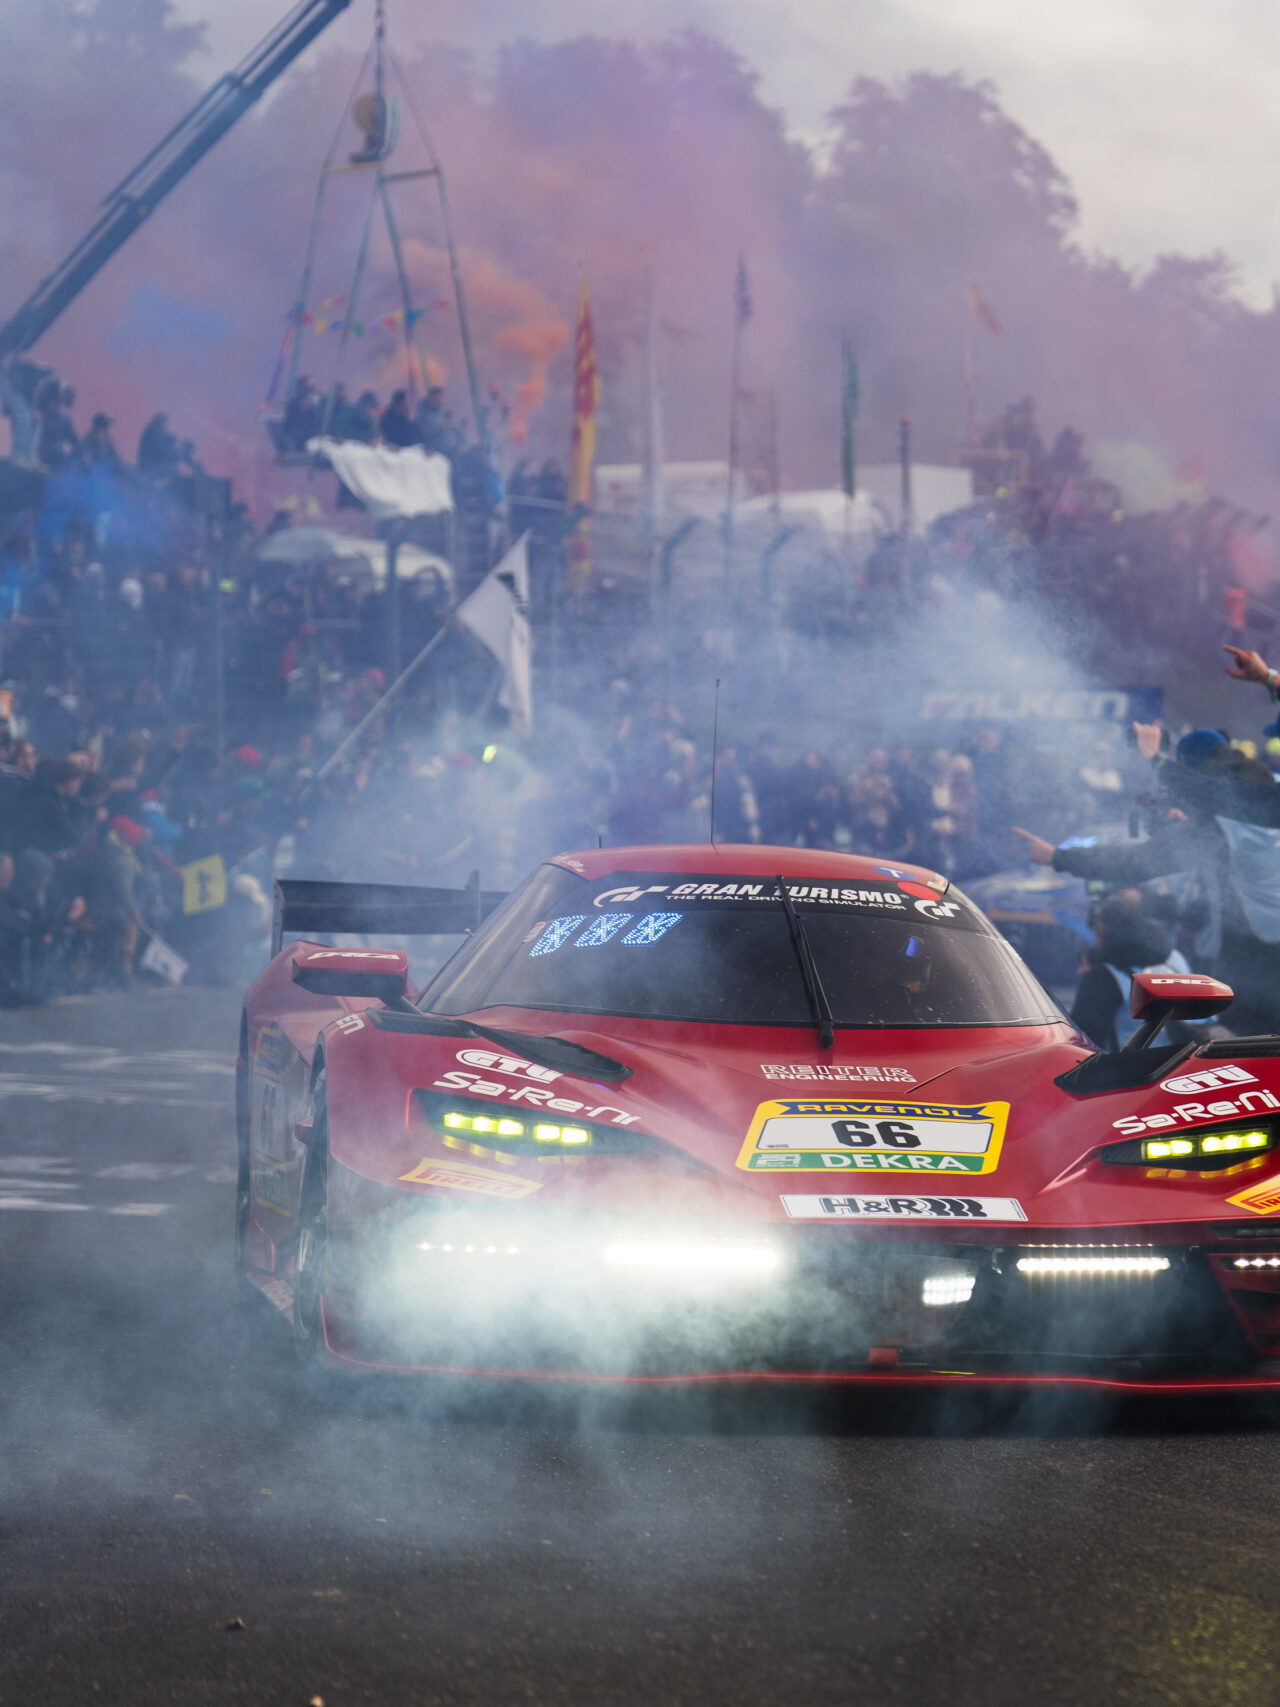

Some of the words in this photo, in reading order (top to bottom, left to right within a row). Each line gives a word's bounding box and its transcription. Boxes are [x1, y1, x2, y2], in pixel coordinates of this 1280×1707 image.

[671, 883, 764, 896] GRAN
[818, 899, 907, 911] SIMULATOR
[457, 1049, 564, 1084] GTU
[760, 1065, 913, 1077] REITER
[766, 1074, 917, 1083] ENGINEERING
[1160, 1065, 1259, 1095] GTU
[797, 1104, 973, 1118] RAVENOL
[831, 1120, 922, 1148] 66
[821, 1154, 970, 1171] DEKRA
[819, 1196, 920, 1217] H&R
